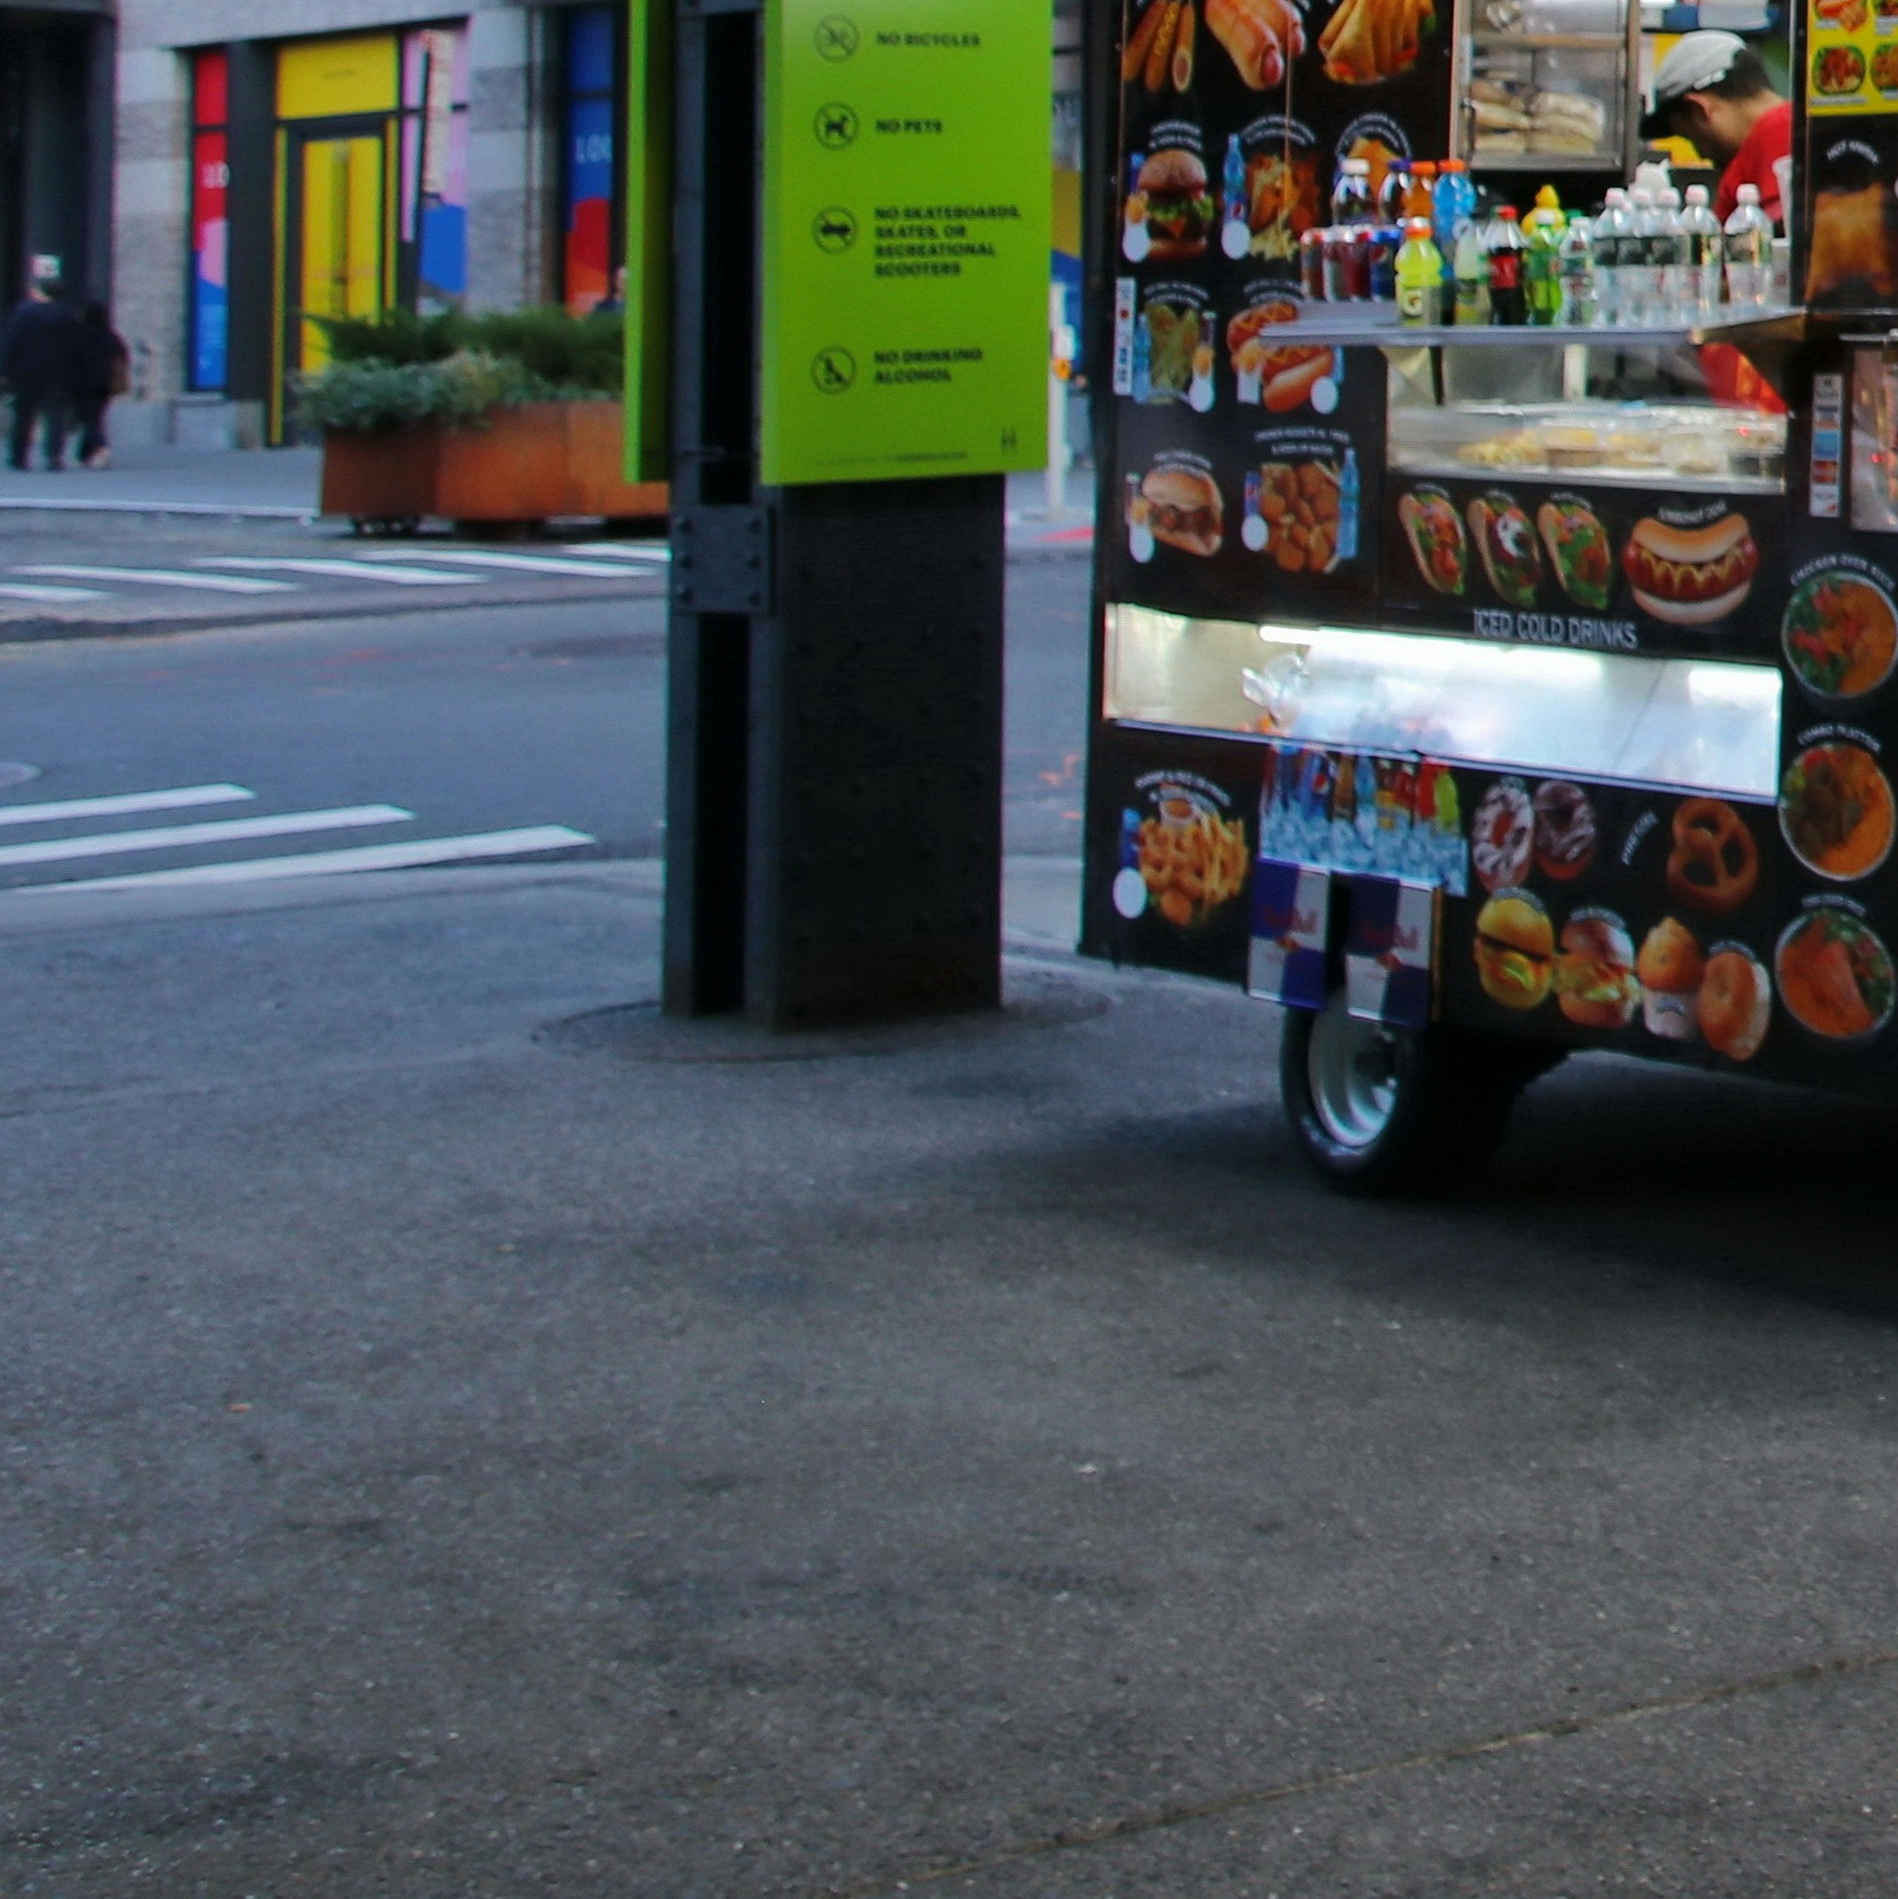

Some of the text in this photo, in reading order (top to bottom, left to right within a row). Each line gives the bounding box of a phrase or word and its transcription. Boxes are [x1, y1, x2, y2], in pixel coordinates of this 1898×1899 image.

[876, 32, 980, 48] NO BICYCLES
[875, 118, 943, 134] NO PETS
[875, 206, 899, 220] NO
[874, 348, 983, 365] NO DRINKING
[875, 368, 952, 384] ALCOHOL
[1473, 607, 1640, 650] ICED COLD DRINKS
